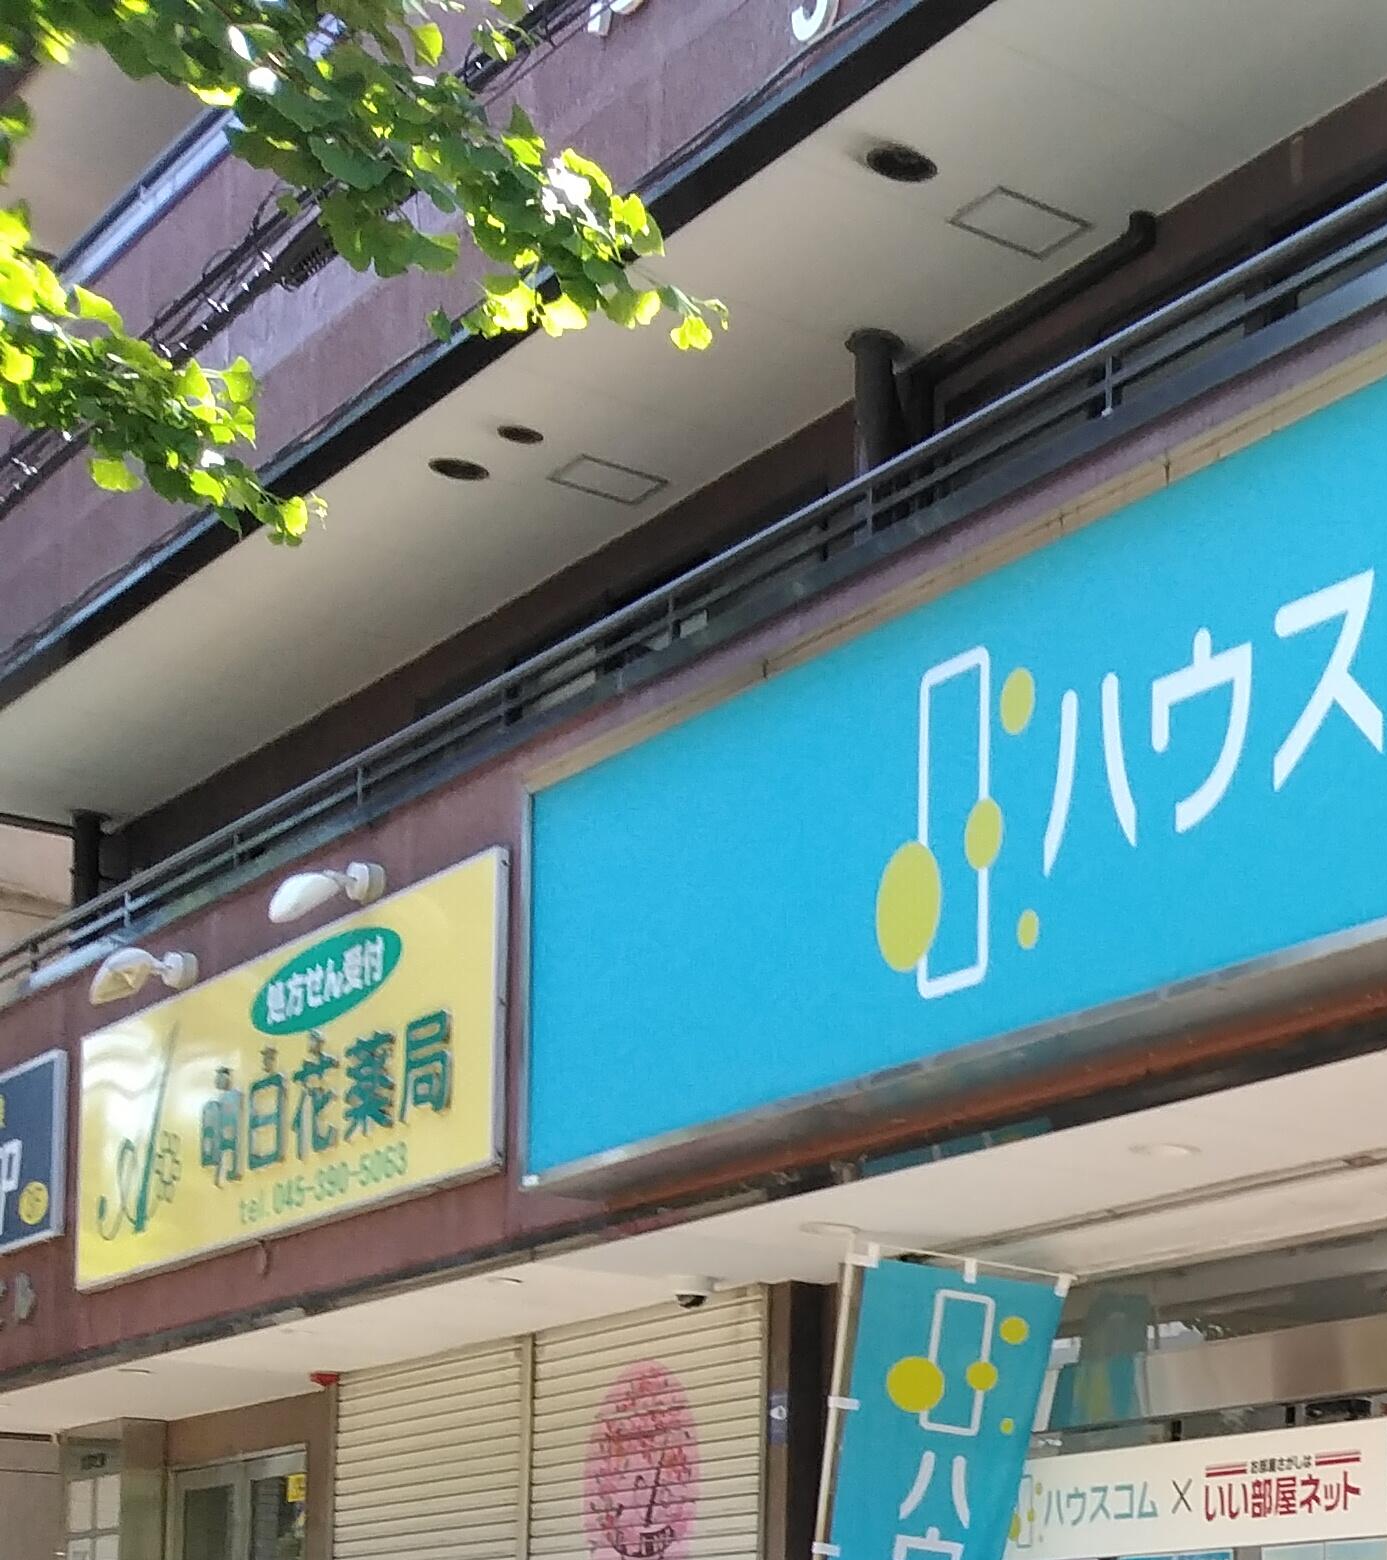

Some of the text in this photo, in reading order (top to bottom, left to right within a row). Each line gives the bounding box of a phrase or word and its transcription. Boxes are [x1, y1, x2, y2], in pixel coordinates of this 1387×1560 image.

[266, 935, 386, 1025] 処方せん受付
[200, 1008, 453, 1189] 明日花薬局
[1044, 1480, 1159, 1527] ハウスコム
[1203, 1470, 1362, 1523] いい部屋ネット
[1250, 1455, 1313, 1474] お部屋さがしは
